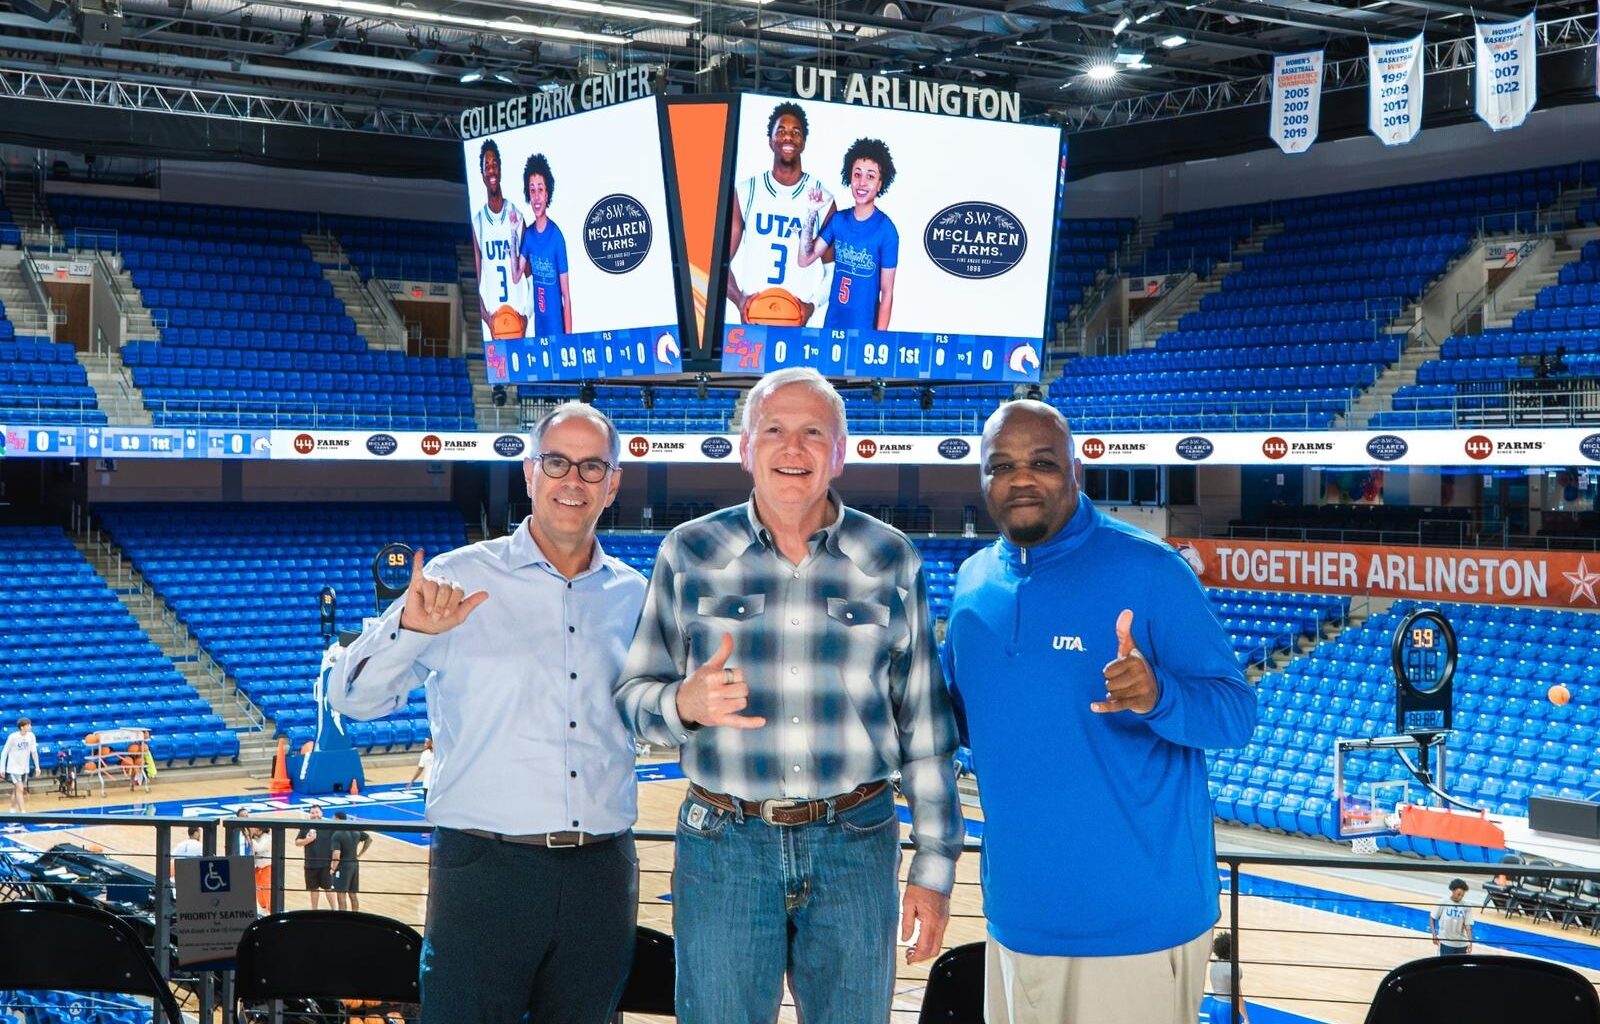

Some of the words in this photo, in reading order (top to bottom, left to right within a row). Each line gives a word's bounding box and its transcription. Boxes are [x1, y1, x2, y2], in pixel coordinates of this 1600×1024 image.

[1489, 49, 1519, 63] 005
[795, 65, 837, 101] UT
[845, 72, 1021, 122] ARLINGTON
[1284, 87, 1310, 99] 2005
[460, 102, 527, 139] COLLEGE
[532, 82, 576, 123] PARK
[581, 66, 652, 111] CENTER
[1284, 101, 1309, 112] 2007
[1383, 100, 1408, 113] 2017
[1283, 114, 1309, 126] 2009
[1384, 114, 1410, 127] 2019
[1284, 127, 1307, 139] 2019
[964, 210, 991, 225] S.W.
[756, 212, 802, 239] UTA
[486, 240, 511, 261] UTA
[951, 244, 1000, 257] FARMS
[767, 243, 788, 285] 3
[496, 265, 509, 303] 3
[838, 277, 852, 304] 5
[831, 330, 845, 339] FLS
[935, 335, 949, 344] FLS
[543, 351, 550, 368] 0
[560, 346, 577, 367] 9.9
[582, 348, 596, 364] 1st
[605, 346, 613, 364] 0
[637, 342, 646, 365] 0
[774, 340, 787, 363] 0
[831, 344, 841, 362] 0
[863, 343, 889, 365] 9.9
[899, 346, 920, 364] 1st
[511, 352, 520, 373] 0
[935, 348, 945, 366] 0
[982, 349, 993, 370] 0
[36, 431, 49, 452] 0
[121, 436, 140, 450] 9.9
[151, 437, 170, 450] 1st
[231, 434, 243, 453] 0
[296, 440, 313, 450] 44
[423, 440, 440, 450] 44
[630, 442, 648, 452] 44
[1084, 443, 1103, 454] 44
[1265, 443, 1286, 454] 44
[1467, 442, 1490, 454] 44
[859, 444, 875, 454] 44
[1216, 547, 1359, 588] TOGETHER
[1365, 550, 1548, 598] ARLINGTON
[1053, 635, 1084, 651] UTA
[1413, 628, 1433, 648] 9.9
[180, 911, 217, 920] PRIORITY
[220, 910, 255, 919] SEATING
[1446, 907, 1465, 917] UTA
